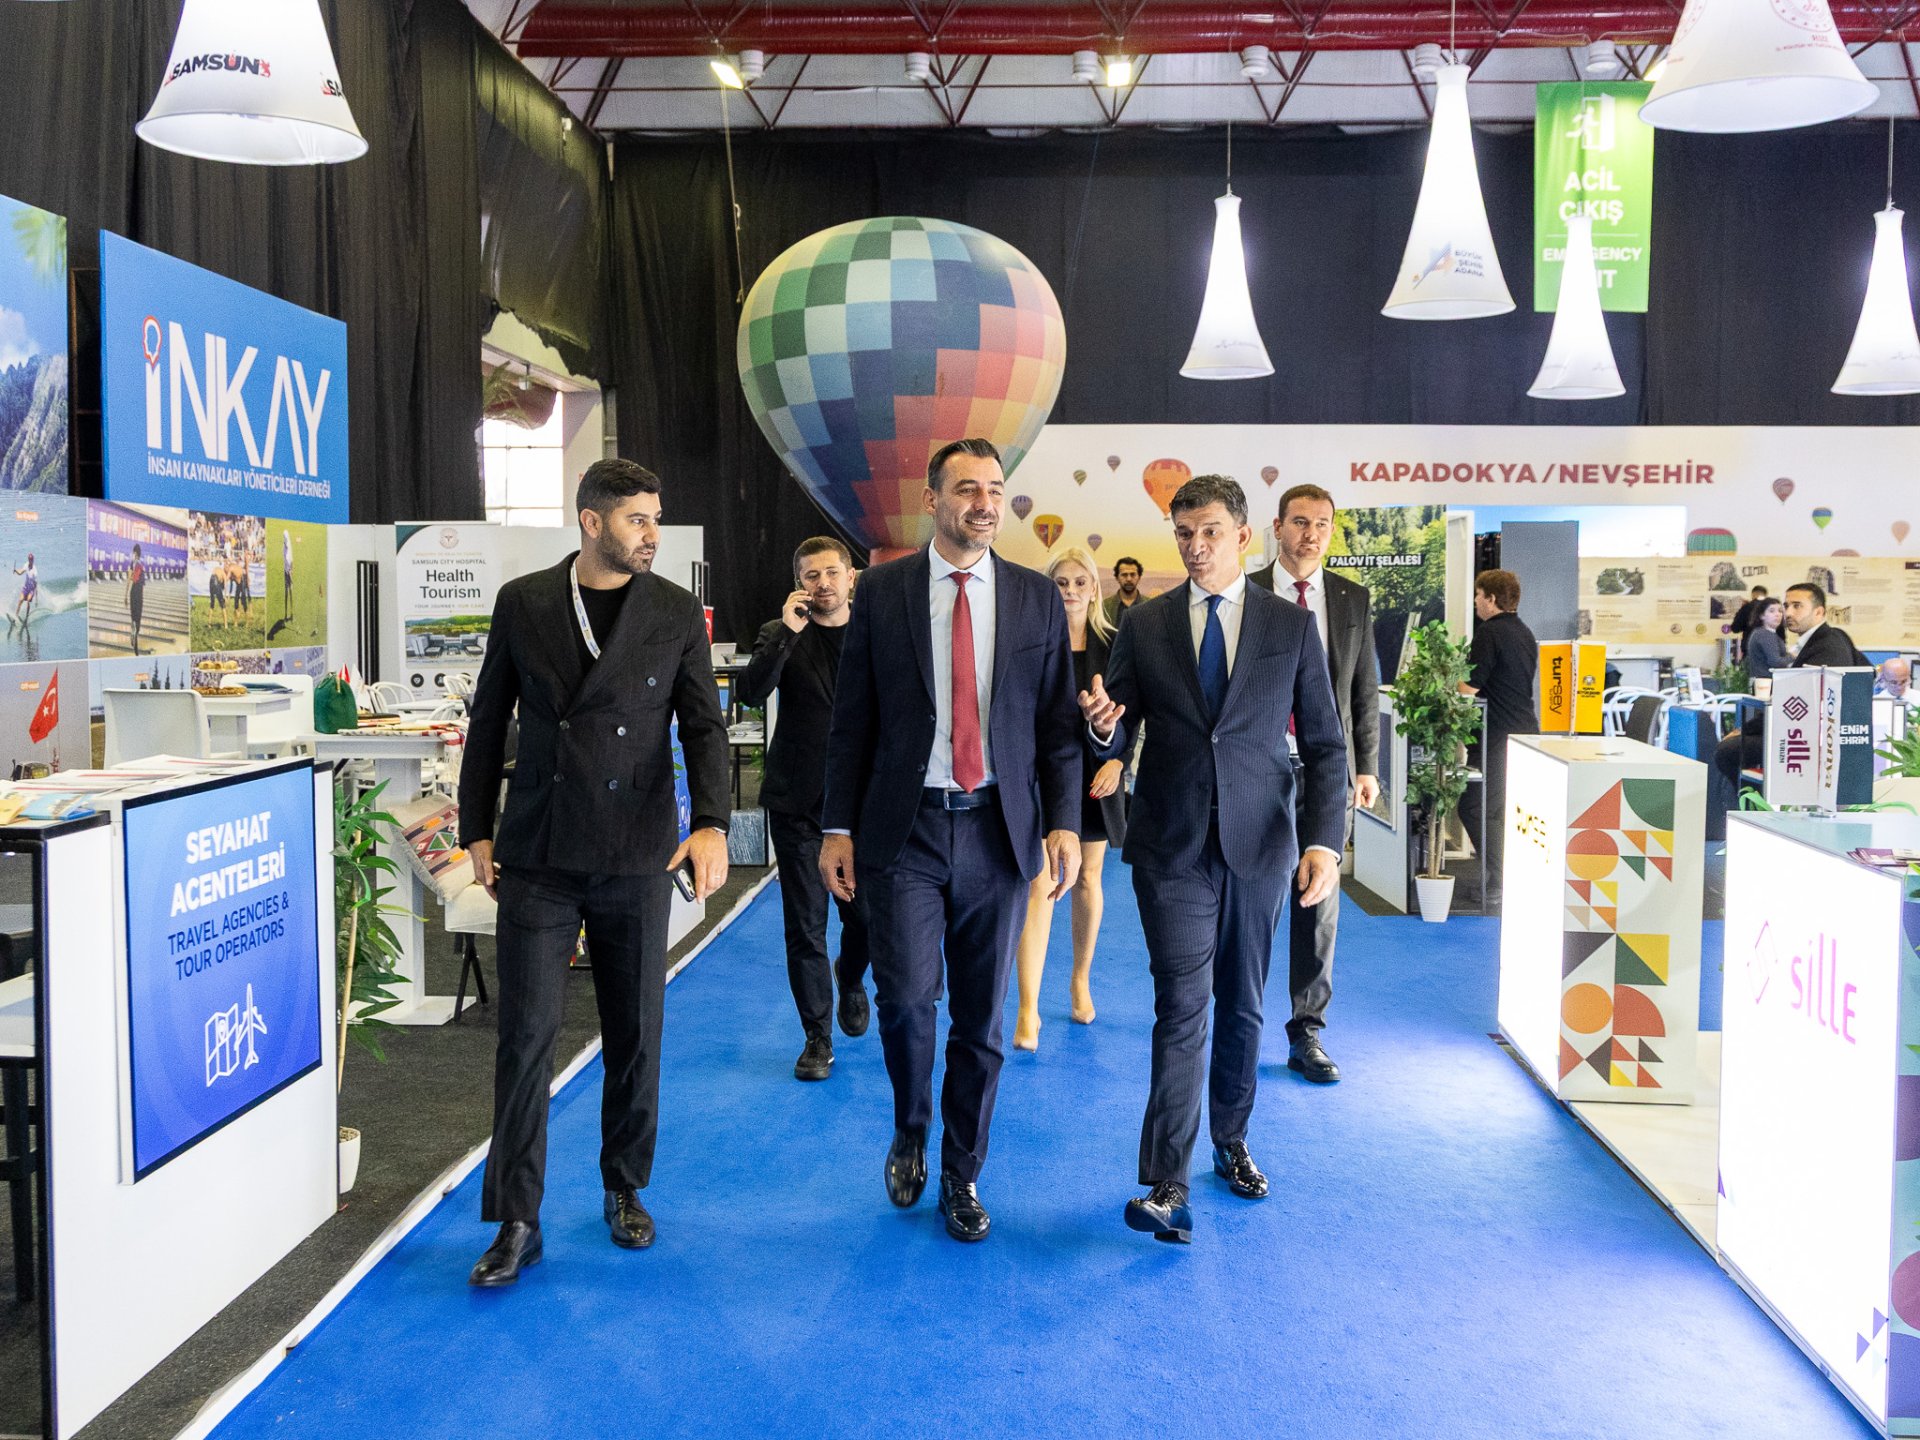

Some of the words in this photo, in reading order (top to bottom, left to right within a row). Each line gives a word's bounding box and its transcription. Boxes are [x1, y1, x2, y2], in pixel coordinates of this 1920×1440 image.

[172, 54, 260, 80] SAMSUN
[1563, 165, 1622, 192] ACİL
[147, 451, 182, 475] İNSAN
[183, 462, 242, 487] KAYNAKLARI
[243, 468, 298, 494] YÖNETİCİLERİ
[298, 479, 331, 499] DERNEĞİ
[426, 568, 474, 582] Health
[1375, 553, 1422, 569] ŞELALESİ
[419, 585, 481, 599] Tourism
[1549, 656, 1564, 715] tursey
[185, 811, 272, 865] SEYAHAT
[169, 841, 286, 917] ACENTELERİ
[168, 919, 218, 956] TRAVEL
[222, 894, 279, 934] AGENCIES
[281, 891, 290, 909] &
[175, 949, 212, 981] TOUR
[215, 917, 285, 964] OPERATORS
